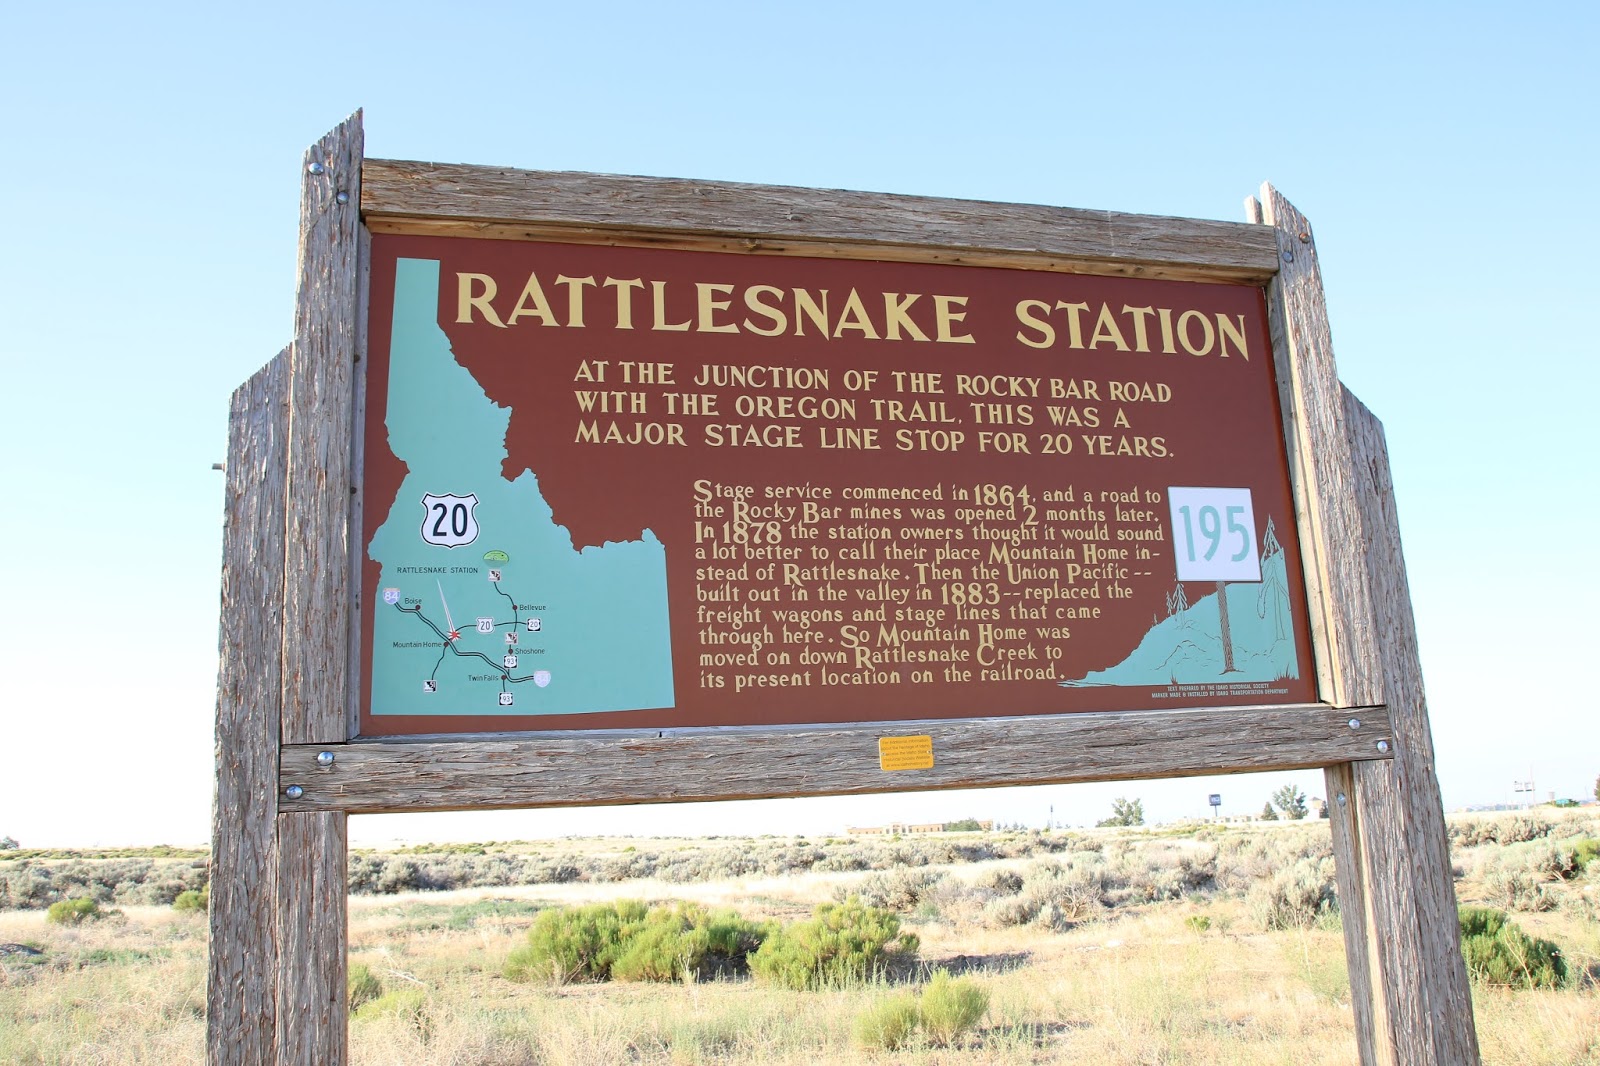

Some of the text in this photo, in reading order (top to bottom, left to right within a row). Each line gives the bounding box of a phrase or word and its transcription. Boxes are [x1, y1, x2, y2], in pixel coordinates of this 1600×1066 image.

[456, 272, 1248, 361] RATTLESNAKE STATION
[574, 360, 1171, 402] AT THE JUNCTION OF THE ROCKY BAR ROAD
[574, 391, 646, 413] WITH
[663, 392, 719, 415] THE
[736, 396, 855, 420] OREGON
[970, 403, 1033, 425] THIS
[1046, 406, 1099, 427] WAS
[1114, 408, 1131, 428] A
[575, 420, 1174, 457] MAJOR STAGE LINE STOP FOR 20 YEARS.
[693, 479, 755, 502] Stage
[765, 482, 832, 498] service
[843, 483, 943, 500] commenced
[953, 484, 968, 500] in
[1044, 485, 1074, 502] and
[1084, 492, 1093, 502] a
[1101, 486, 1139, 503] road
[1145, 490, 1160, 503] to
[432, 503, 468, 537] 20
[694, 503, 724, 517] the
[733, 501, 796, 523] Rocky
[802, 502, 842, 523] Bar
[851, 503, 901, 519] mines
[910, 508, 945, 520] was
[955, 503, 1015, 524] opened
[1024, 505, 1038, 525] 2
[1046, 503, 1105, 521] months
[695, 520, 1164, 546] In 1878 the station owners thought it would sound
[1179, 506, 1250, 562] 195
[695, 548, 706, 559] a
[713, 539, 737, 559] lot
[744, 544, 802, 560] better
[811, 545, 829, 559] to
[839, 540, 875, 559] call
[884, 541, 927, 560] their
[935, 541, 980, 564] place
[988, 542, 1076, 564] Mountain
[1083, 543, 1128, 564] Home
[696, 561, 749, 580] stead
[756, 563, 775, 580] of
[913, 561, 962, 585] Then
[971, 561, 999, 579] the
[1007, 563, 1059, 584] Union
[1067, 563, 1128, 584] Pacific
[384, 592, 398, 601] 84
[697, 581, 739, 601] built
[748, 587, 780, 601] out
[792, 584, 808, 601] in
[817, 581, 847, 601] the
[856, 581, 910, 604] valley
[916, 586, 932, 600] in
[1106, 580, 1133, 598] the
[480, 621, 490, 630] 20
[697, 601, 1100, 630] freight wagons and stage lines that came
[699, 624, 774, 651] through
[840, 624, 870, 648] So
[877, 623, 970, 647] Mountain
[978, 624, 1027, 645] Home
[1036, 628, 1070, 639] was
[700, 642, 1062, 669] moved on down Rattlesnake Creek to
[701, 670, 724, 688] its
[735, 671, 811, 692] present
[822, 665, 900, 685] location
[911, 670, 933, 683] on
[944, 662, 971, 682] the
